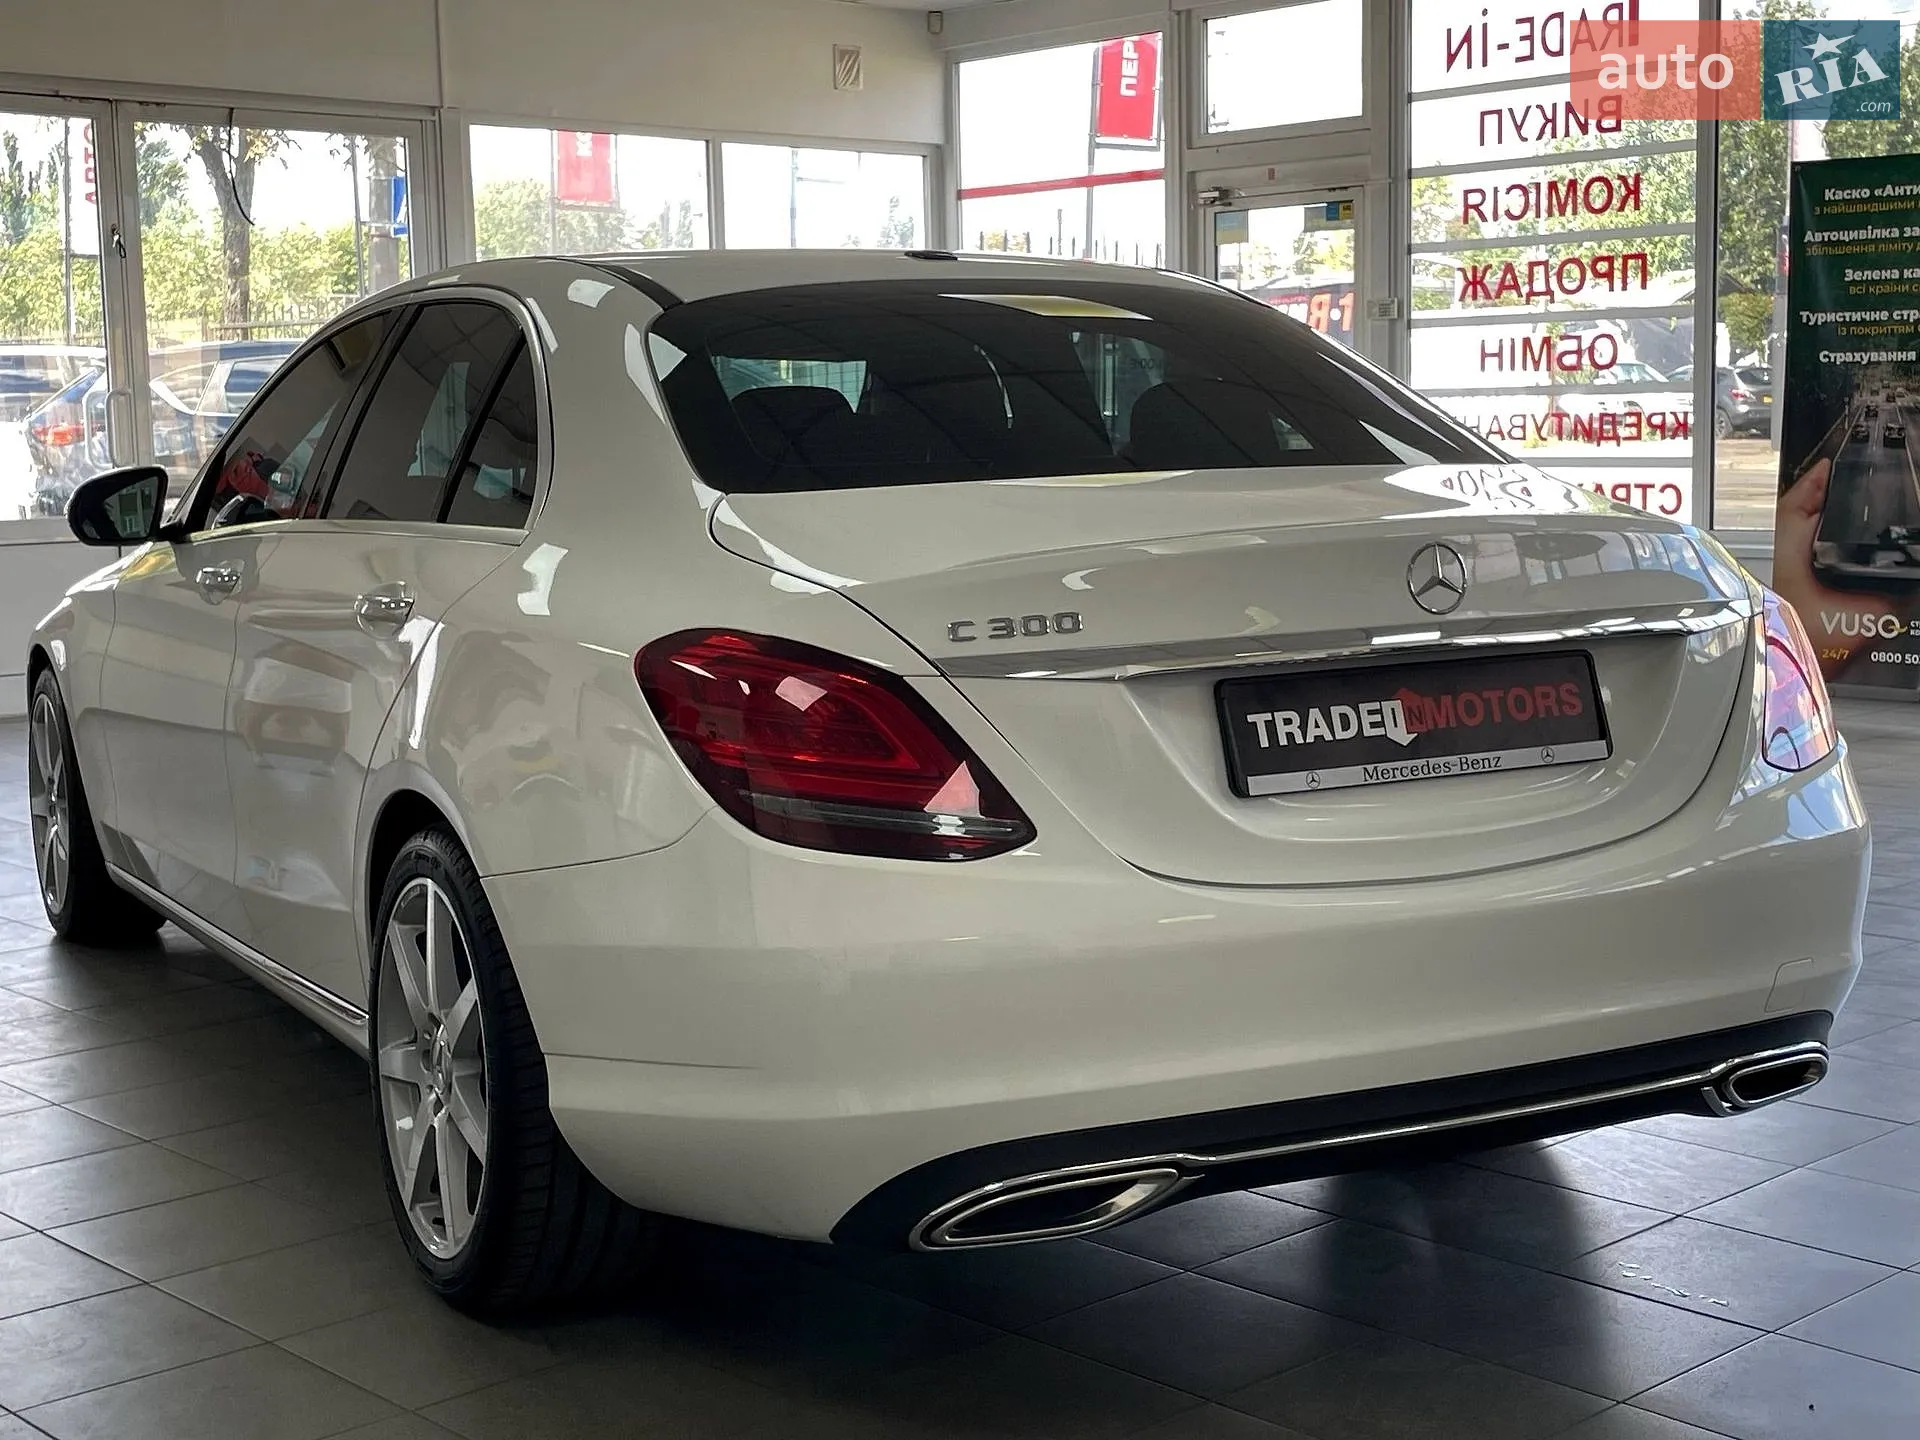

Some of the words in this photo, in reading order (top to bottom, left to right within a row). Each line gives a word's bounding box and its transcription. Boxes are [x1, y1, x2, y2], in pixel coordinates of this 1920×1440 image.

[1824, 188, 1870, 200] Каско
[1813, 206, 1820, 215] з
[1823, 201, 1915, 214] найшвидшими
[1803, 225, 1900, 242] Автоцивілка
[1805, 243, 1875, 256] збільшення
[1879, 242, 1914, 253] ліміту
[1844, 268, 1900, 281] Зелена
[1850, 283, 1866, 295] всі
[1869, 283, 1909, 295] країни
[1800, 310, 1890, 325] Туристичне
[1892, 309, 1920, 323] стр
[1837, 325, 1847, 336] із
[1850, 324, 1914, 337] покриттям
[1818, 350, 1916, 365] Страхування
[947, 620, 977, 642] C
[987, 611, 1084, 639] 300
[1822, 648, 1850, 660] 24/7
[1870, 651, 1902, 663] 0800
[1904, 653, 1920, 665] 50
[1362, 754, 1503, 783] Mercedes-Benz
